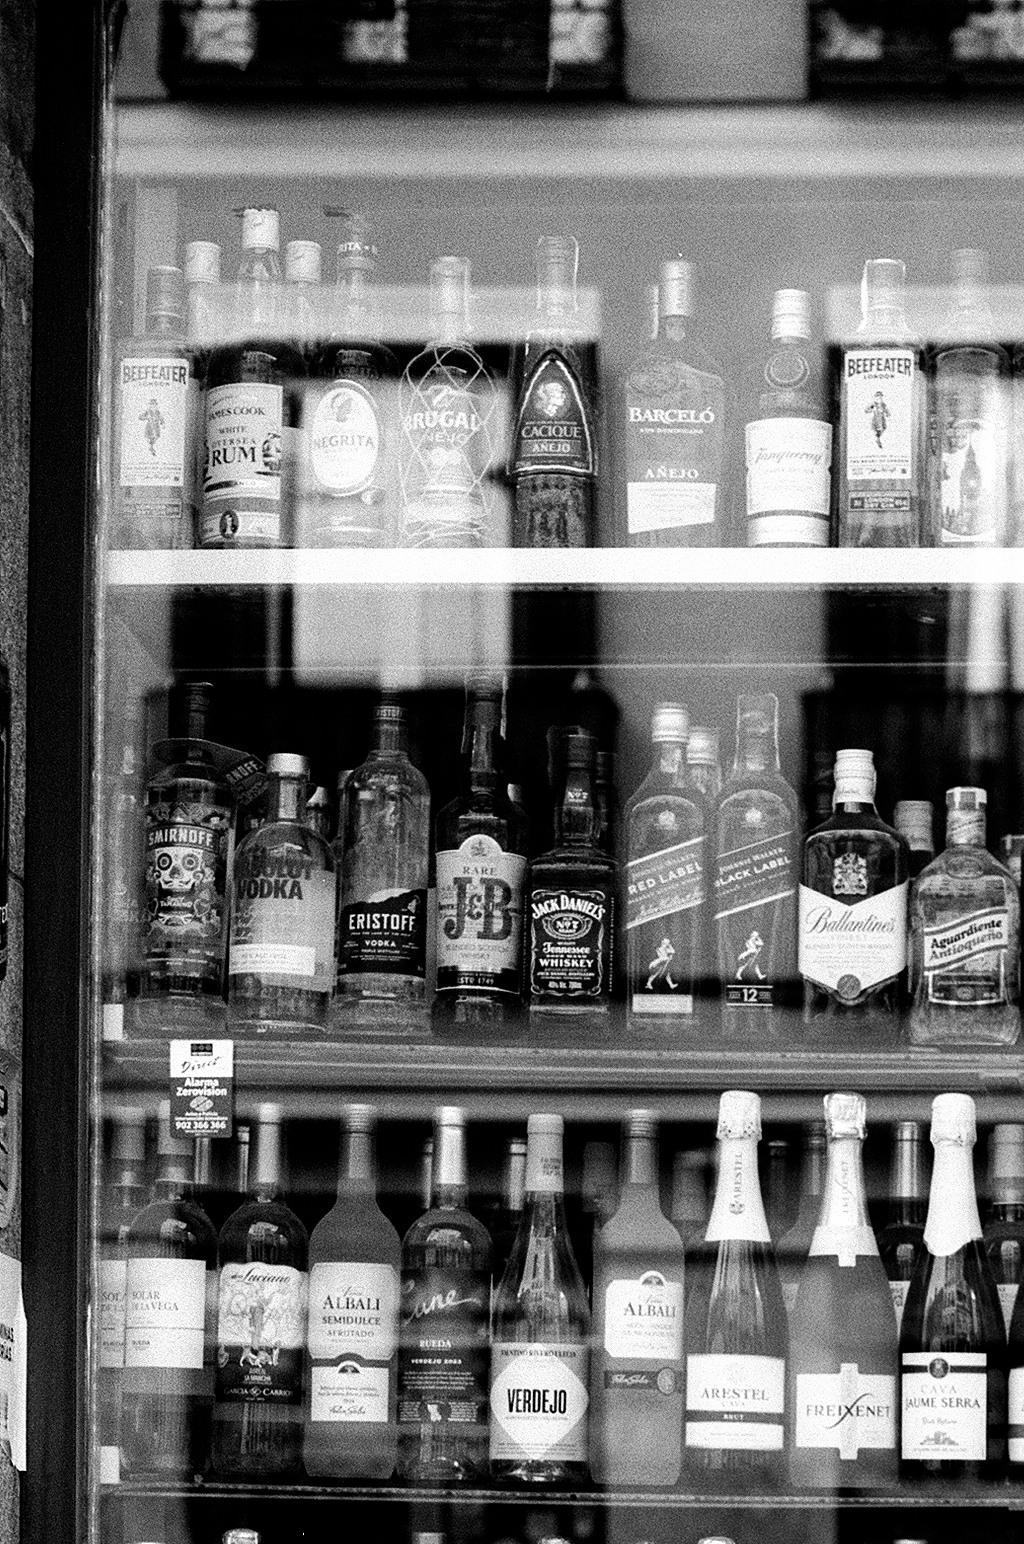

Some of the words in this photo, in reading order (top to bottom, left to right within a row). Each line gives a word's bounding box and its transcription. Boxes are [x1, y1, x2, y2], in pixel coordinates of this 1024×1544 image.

[847, 356, 912, 377] BEEFEATER
[122, 365, 187, 386] BEEFEATER
[232, 406, 266, 417] COOK
[628, 406, 715, 425] BARCELÓ
[403, 410, 479, 430] BRUGAL
[218, 425, 247, 435] WHITE
[521, 423, 581, 438] CACIQUE
[314, 436, 374, 449] NEGRITA
[532, 440, 572, 454] AÑEJO
[212, 446, 257, 466] RUM
[644, 466, 700, 479] AÑEJO
[148, 827, 214, 848] SMIRNOFF
[462, 865, 497, 876] RARE
[715, 868, 752, 887] BLACK
[755, 856, 791, 876] LABEL
[628, 879, 656, 895] RED
[660, 862, 702, 885] LABEL
[443, 876, 513, 942] J&B
[532, 896, 560, 920] JACK
[559, 894, 606, 920] DANIEL'S
[349, 913, 416, 931] ERISTOFF
[806, 905, 896, 934] Ballantine's
[930, 919, 1002, 950] Aguardiente
[364, 939, 397, 947] VODKA
[543, 943, 590, 954] Tennessee
[929, 930, 1003, 961] Antioqueño
[539, 958, 594, 968] WHISKEY
[743, 989, 758, 1002] 12
[185, 1078, 219, 1087] Alarma
[176, 1087, 227, 1096] Zerovision
[323, 1295, 381, 1311] ALBALI
[624, 1302, 676, 1318] ALBALI
[322, 1315, 381, 1326] SEMIDULCE
[327, 1329, 374, 1339] AFRUTADO
[419, 1339, 452, 1349] RUEDA
[700, 1388, 770, 1402] ARESTEL
[921, 1385, 957, 1394] CAVA
[507, 1388, 568, 1414] VERDEJO
[905, 1398, 938, 1410] JAUME
[942, 1398, 981, 1409] SERRA
[806, 1393, 890, 1429] FREIXENET
